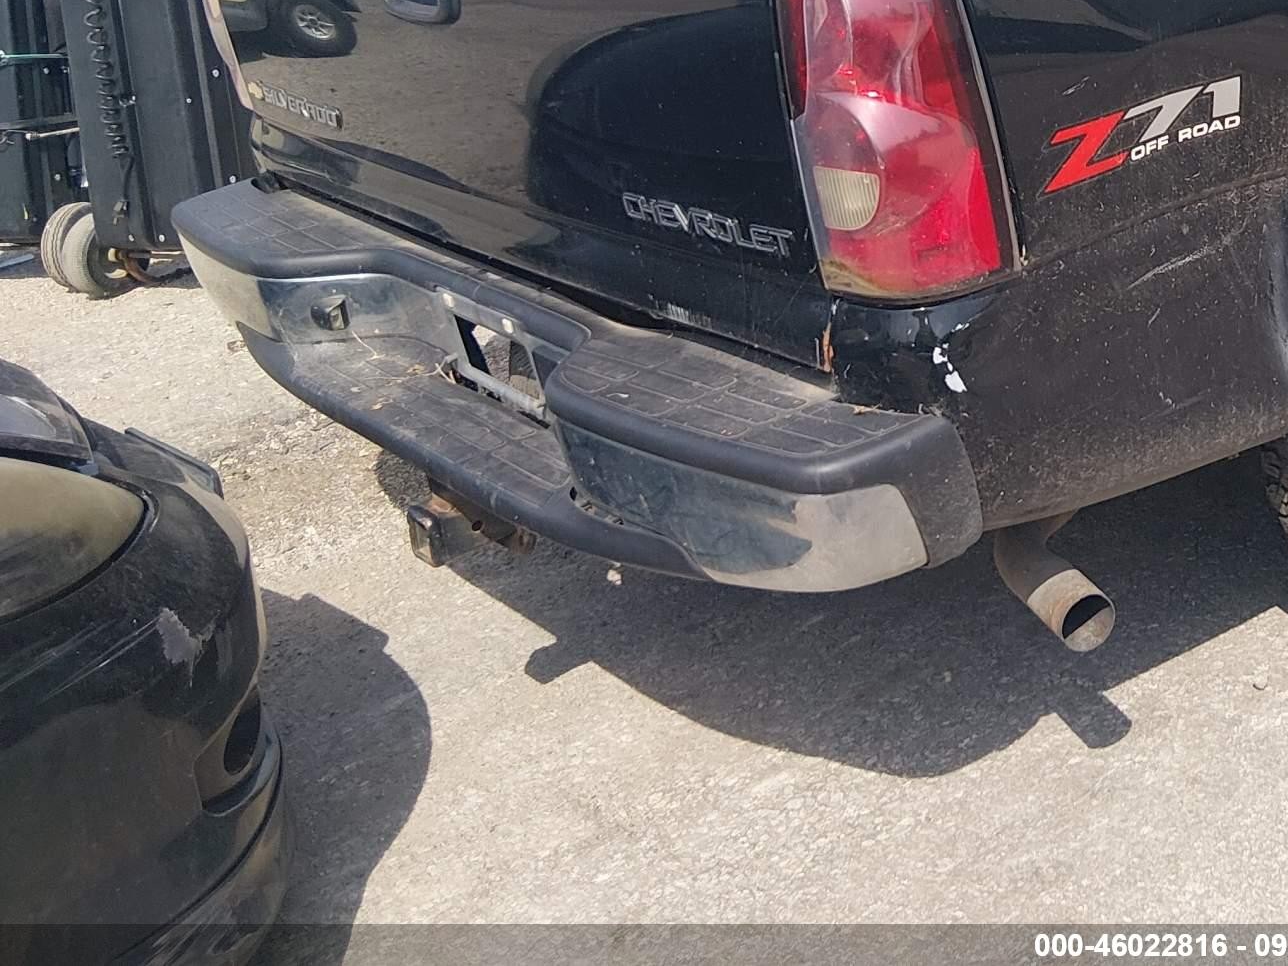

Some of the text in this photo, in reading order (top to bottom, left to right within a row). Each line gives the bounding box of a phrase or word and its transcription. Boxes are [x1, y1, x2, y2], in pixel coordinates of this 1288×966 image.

[262, 87, 343, 128] SILVERADO
[1043, 75, 1241, 194] Z71
[1130, 116, 1241, 162] OFF ROAD
[622, 192, 794, 258] CHEVROLET
